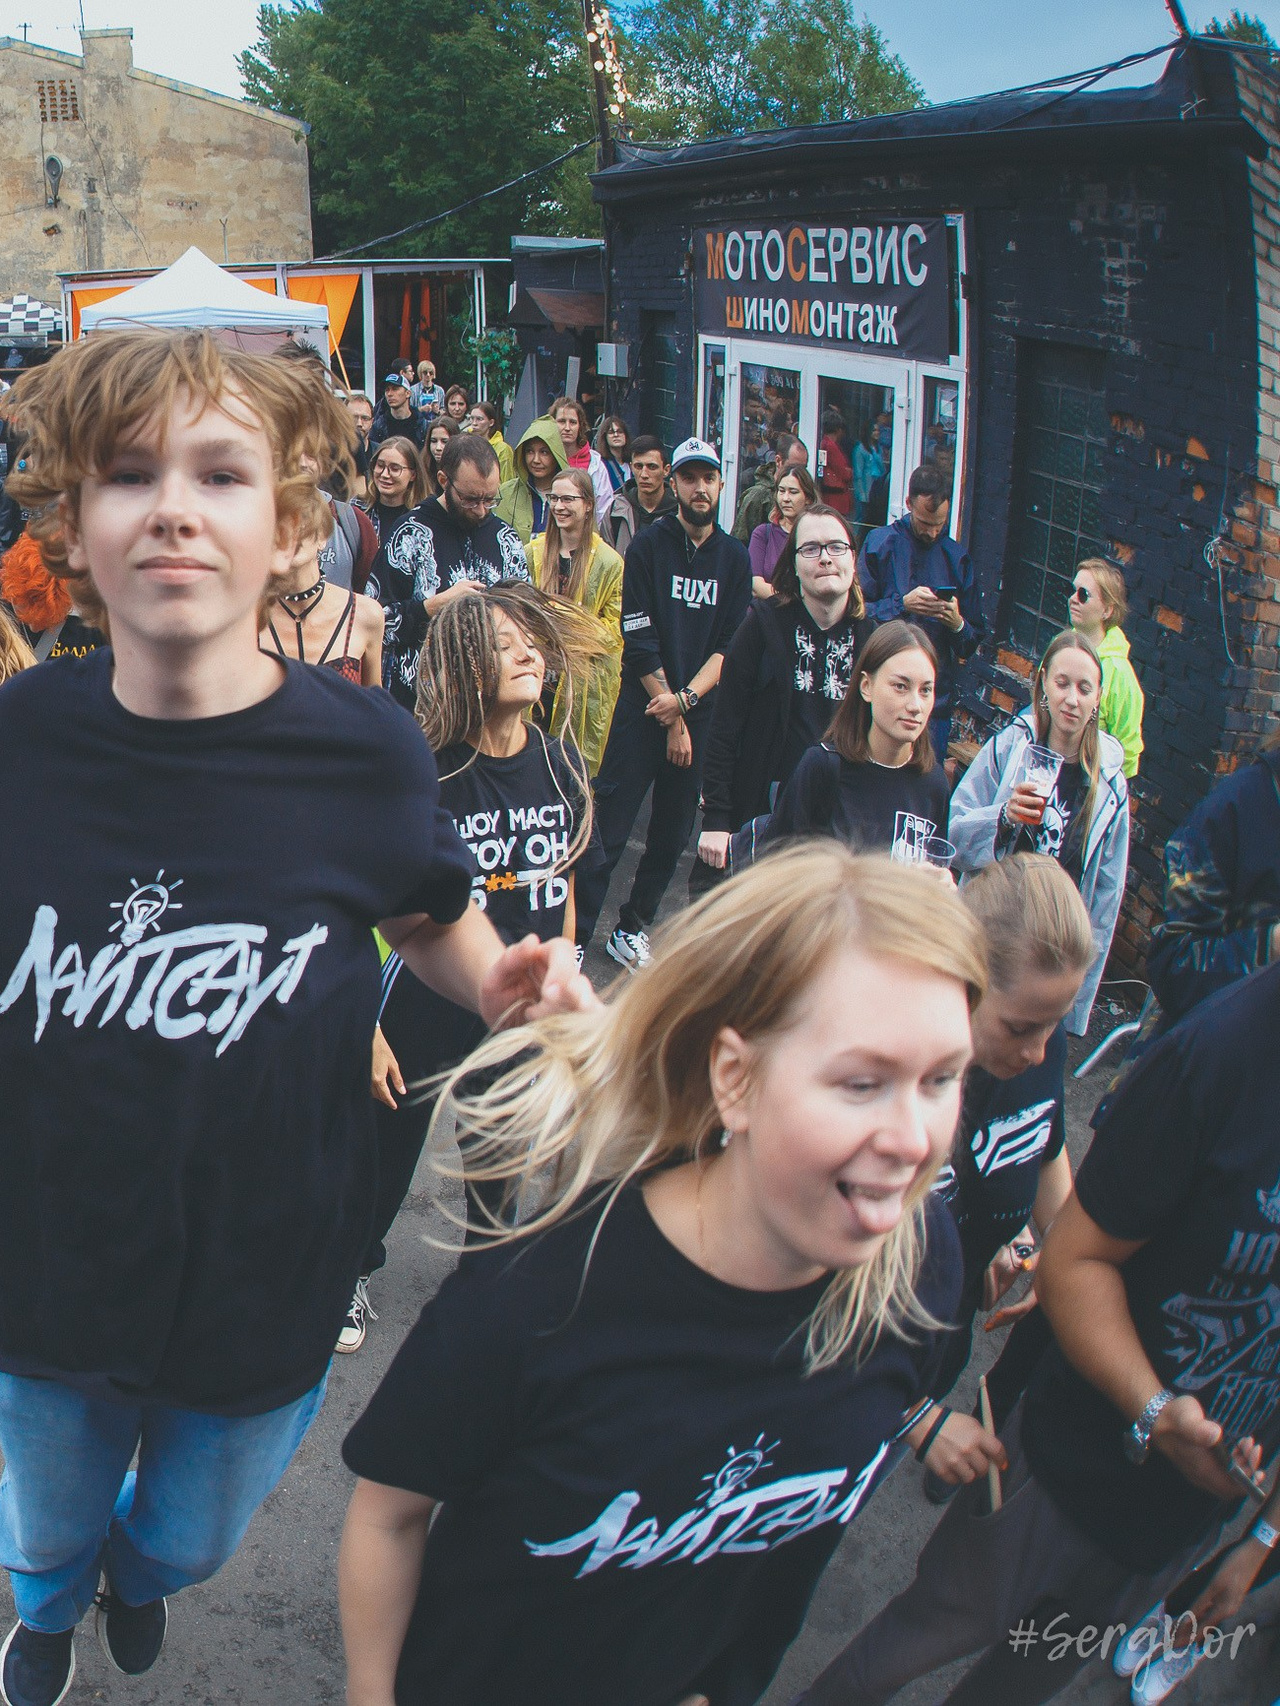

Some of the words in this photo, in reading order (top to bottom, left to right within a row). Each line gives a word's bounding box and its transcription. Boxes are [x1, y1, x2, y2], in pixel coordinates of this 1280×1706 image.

[705, 223, 928, 287] МОТОСЕРВИС
[508, 803, 565, 832] МАСТ
[524, 830, 570, 865] ОН
